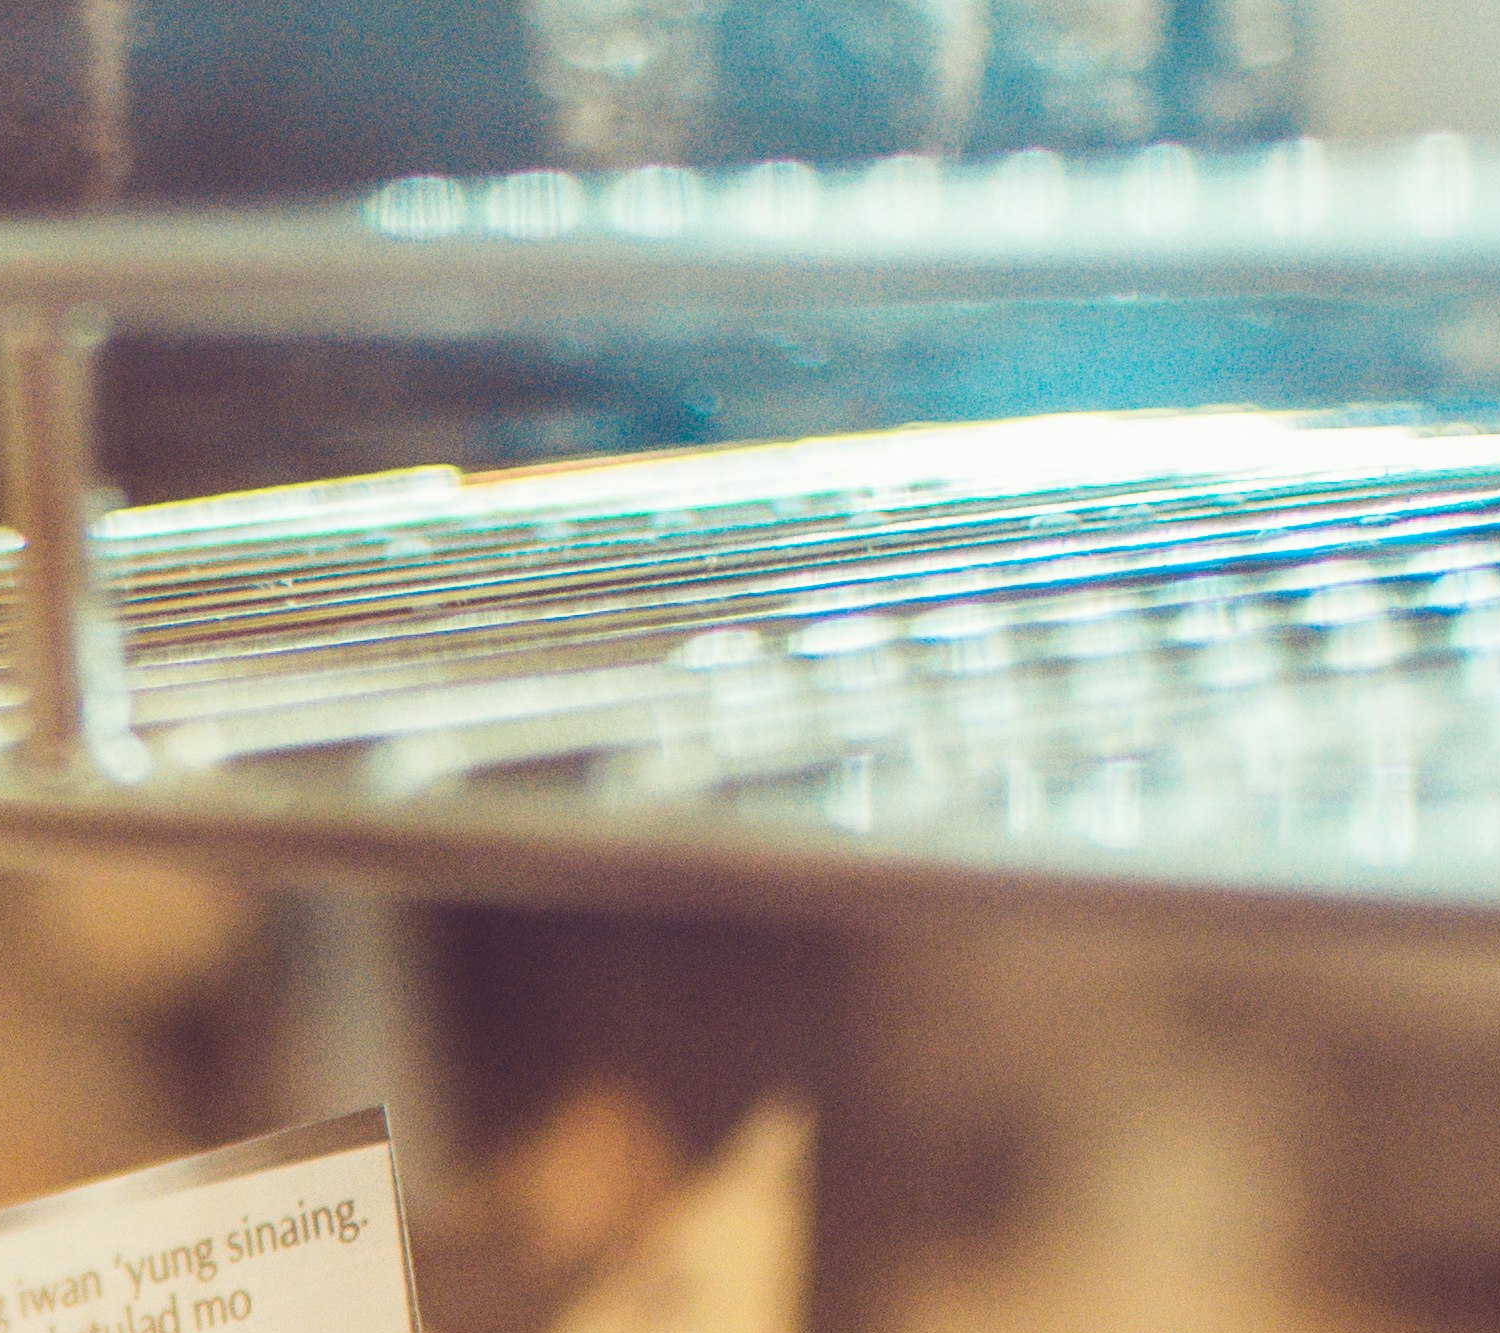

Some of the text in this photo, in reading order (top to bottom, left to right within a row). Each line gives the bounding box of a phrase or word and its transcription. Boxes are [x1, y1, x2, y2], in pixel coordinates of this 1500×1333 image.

[16, 1270, 103, 1321] iwan
[224, 1198, 369, 1264] sinaing.
[193, 1288, 253, 1333] mo
